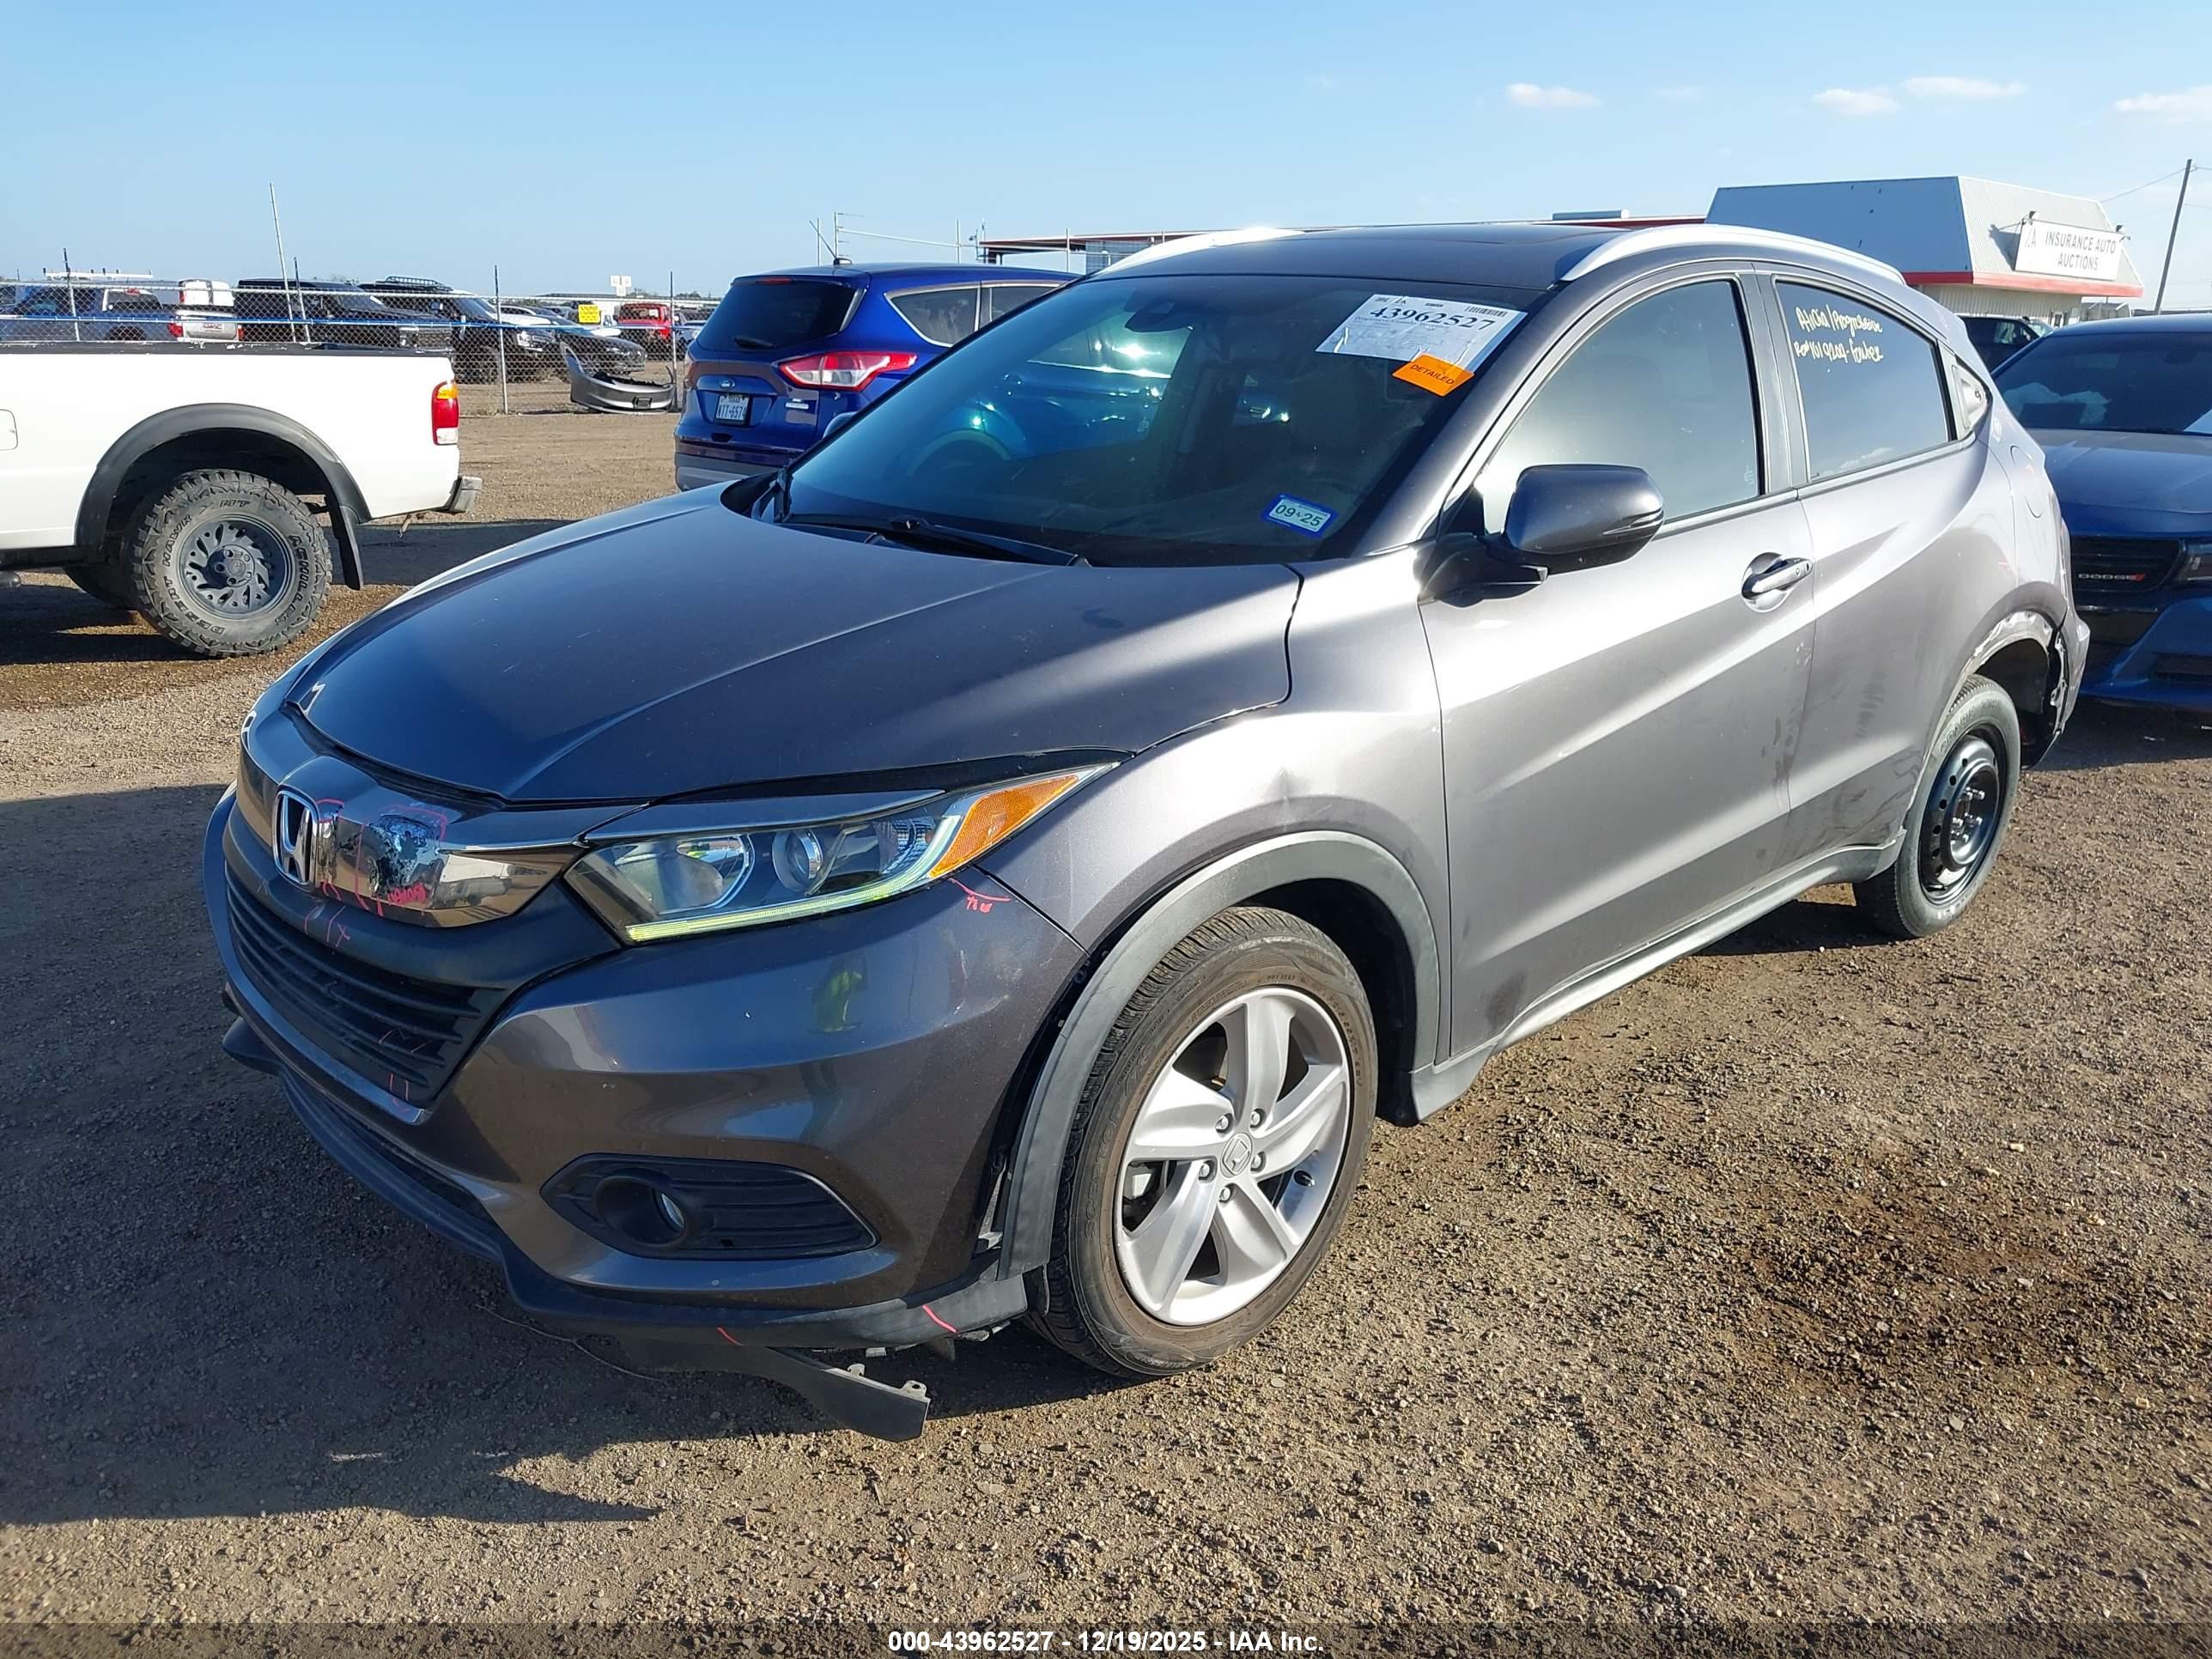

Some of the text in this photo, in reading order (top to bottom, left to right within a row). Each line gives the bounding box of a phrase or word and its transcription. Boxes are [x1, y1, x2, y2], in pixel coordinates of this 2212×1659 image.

[2045, 230, 2117, 254] INSURANCE AUTO
[2057, 252, 2099, 271] AUCTIONS
[1370, 307, 1496, 331] 43962527
[1410, 363, 1455, 386] DETAILED
[1275, 505, 1323, 526] 09 25
[163, 514, 192, 568] HAWK
[274, 533, 311, 626] ACHILLES
[164, 575, 226, 635] DESERT
